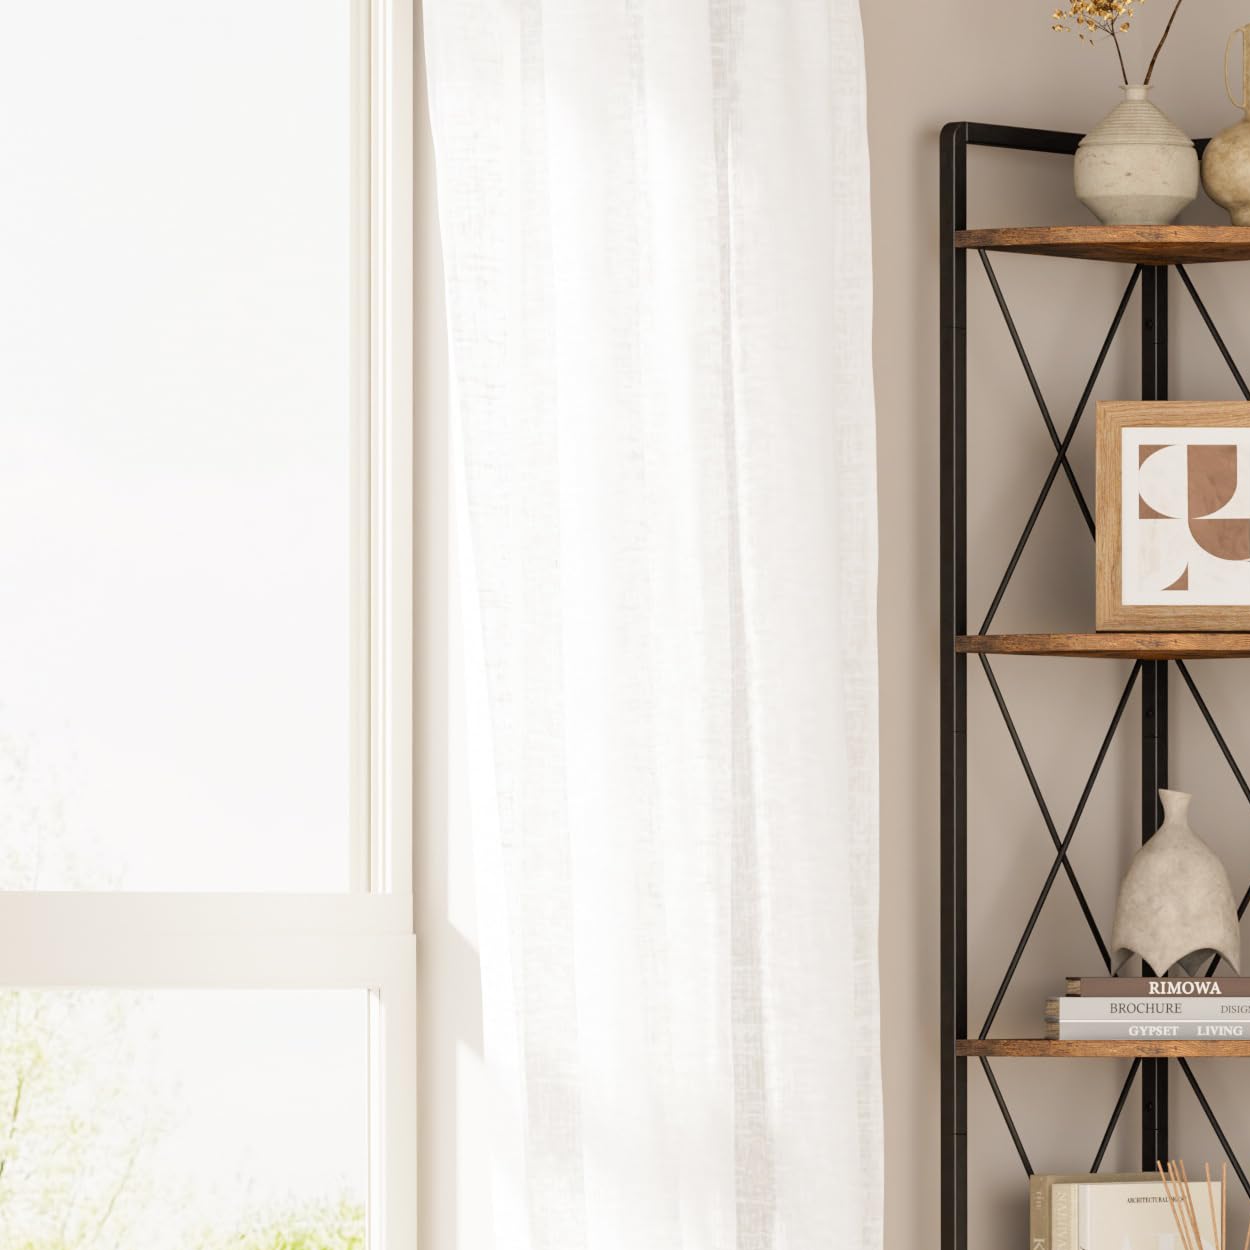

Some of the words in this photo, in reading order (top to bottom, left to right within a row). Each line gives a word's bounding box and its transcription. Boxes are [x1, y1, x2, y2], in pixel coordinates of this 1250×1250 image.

[1148, 980, 1222, 996] RIMOWA
[1109, 1002, 1182, 1014] BROCHURE
[1128, 1026, 1180, 1036] GYPSET
[1196, 1026, 1243, 1036] LIVING
